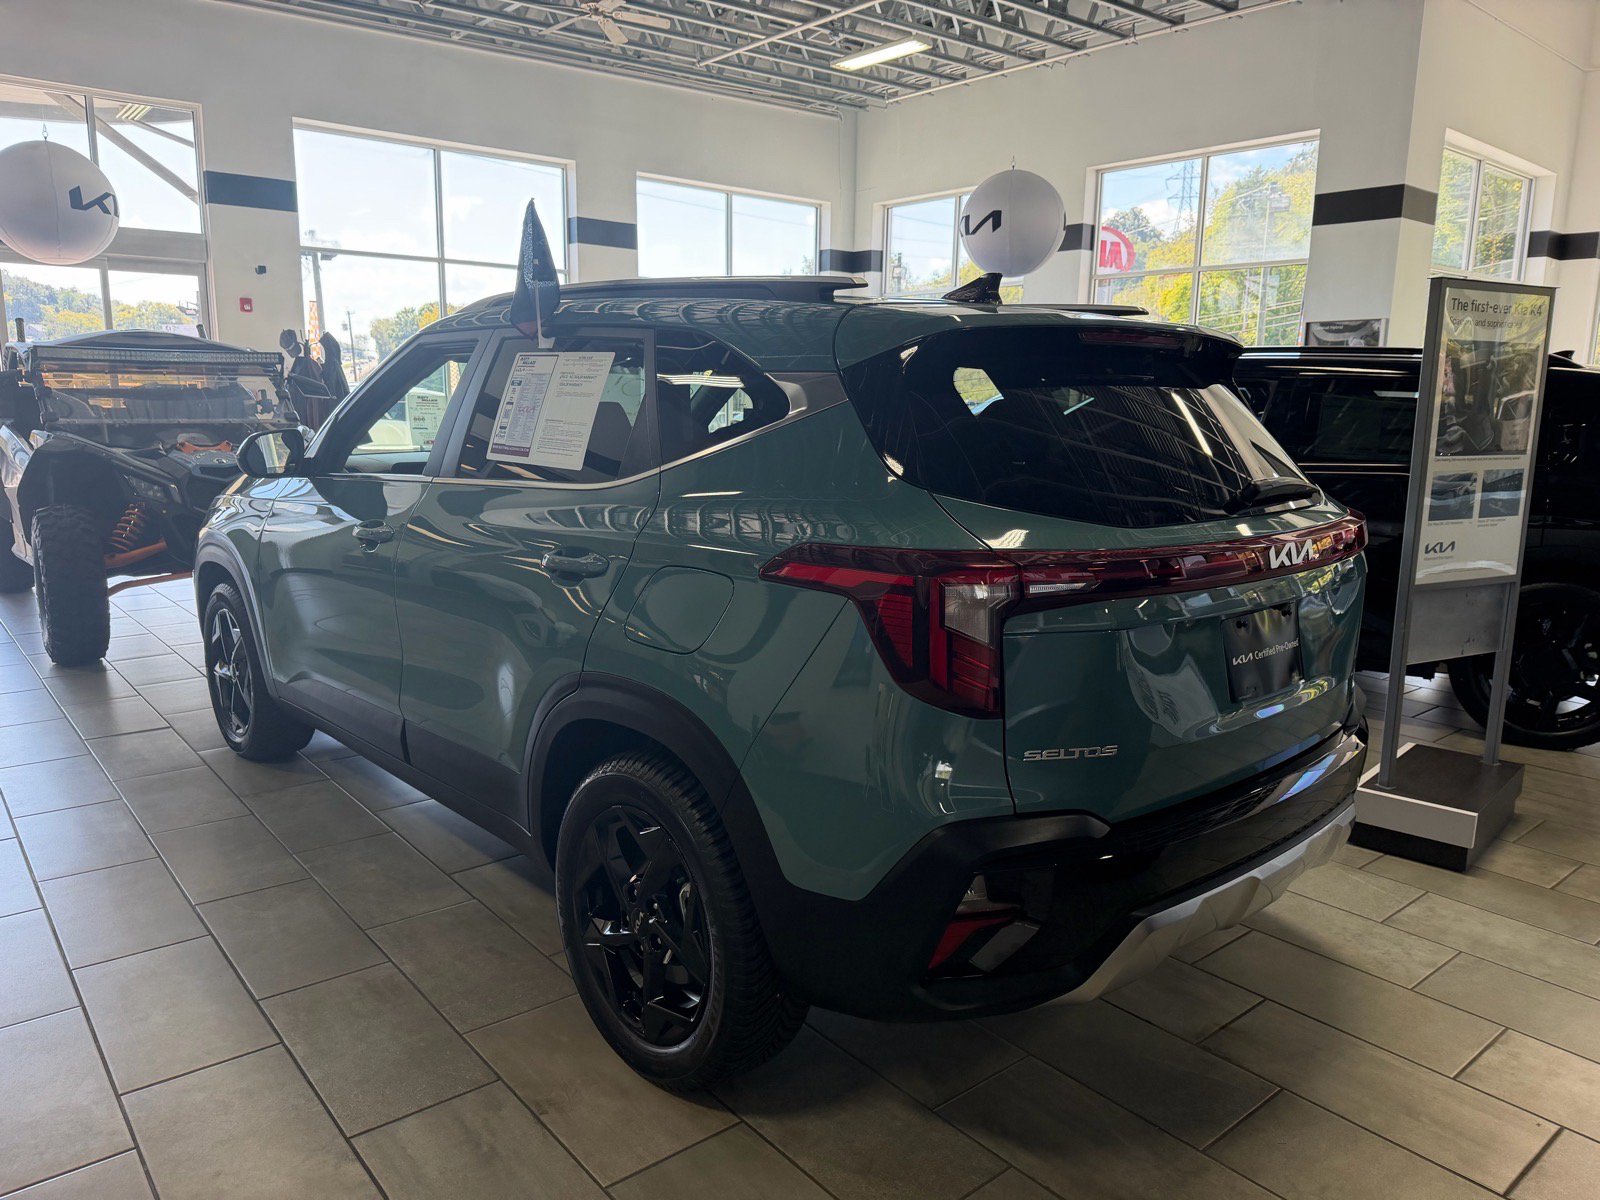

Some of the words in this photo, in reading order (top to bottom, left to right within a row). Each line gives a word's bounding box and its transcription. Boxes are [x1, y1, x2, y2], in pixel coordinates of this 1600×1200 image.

[69, 186, 119, 217] KI
[1099, 240, 1124, 270] IA
[1451, 297, 1469, 311] The
[1470, 299, 1512, 314] first-ever
[1514, 303, 1528, 316] Kia
[1530, 304, 1543, 316] K4
[1450, 316, 1472, 327] Spac
[1474, 319, 1486, 327] and
[1269, 539, 1313, 569] KIA
[1424, 541, 1456, 555] KIA
[1232, 652, 1253, 666] KIA
[1254, 646, 1276, 660] Certified
[1023, 745, 1118, 761] SELTOS
